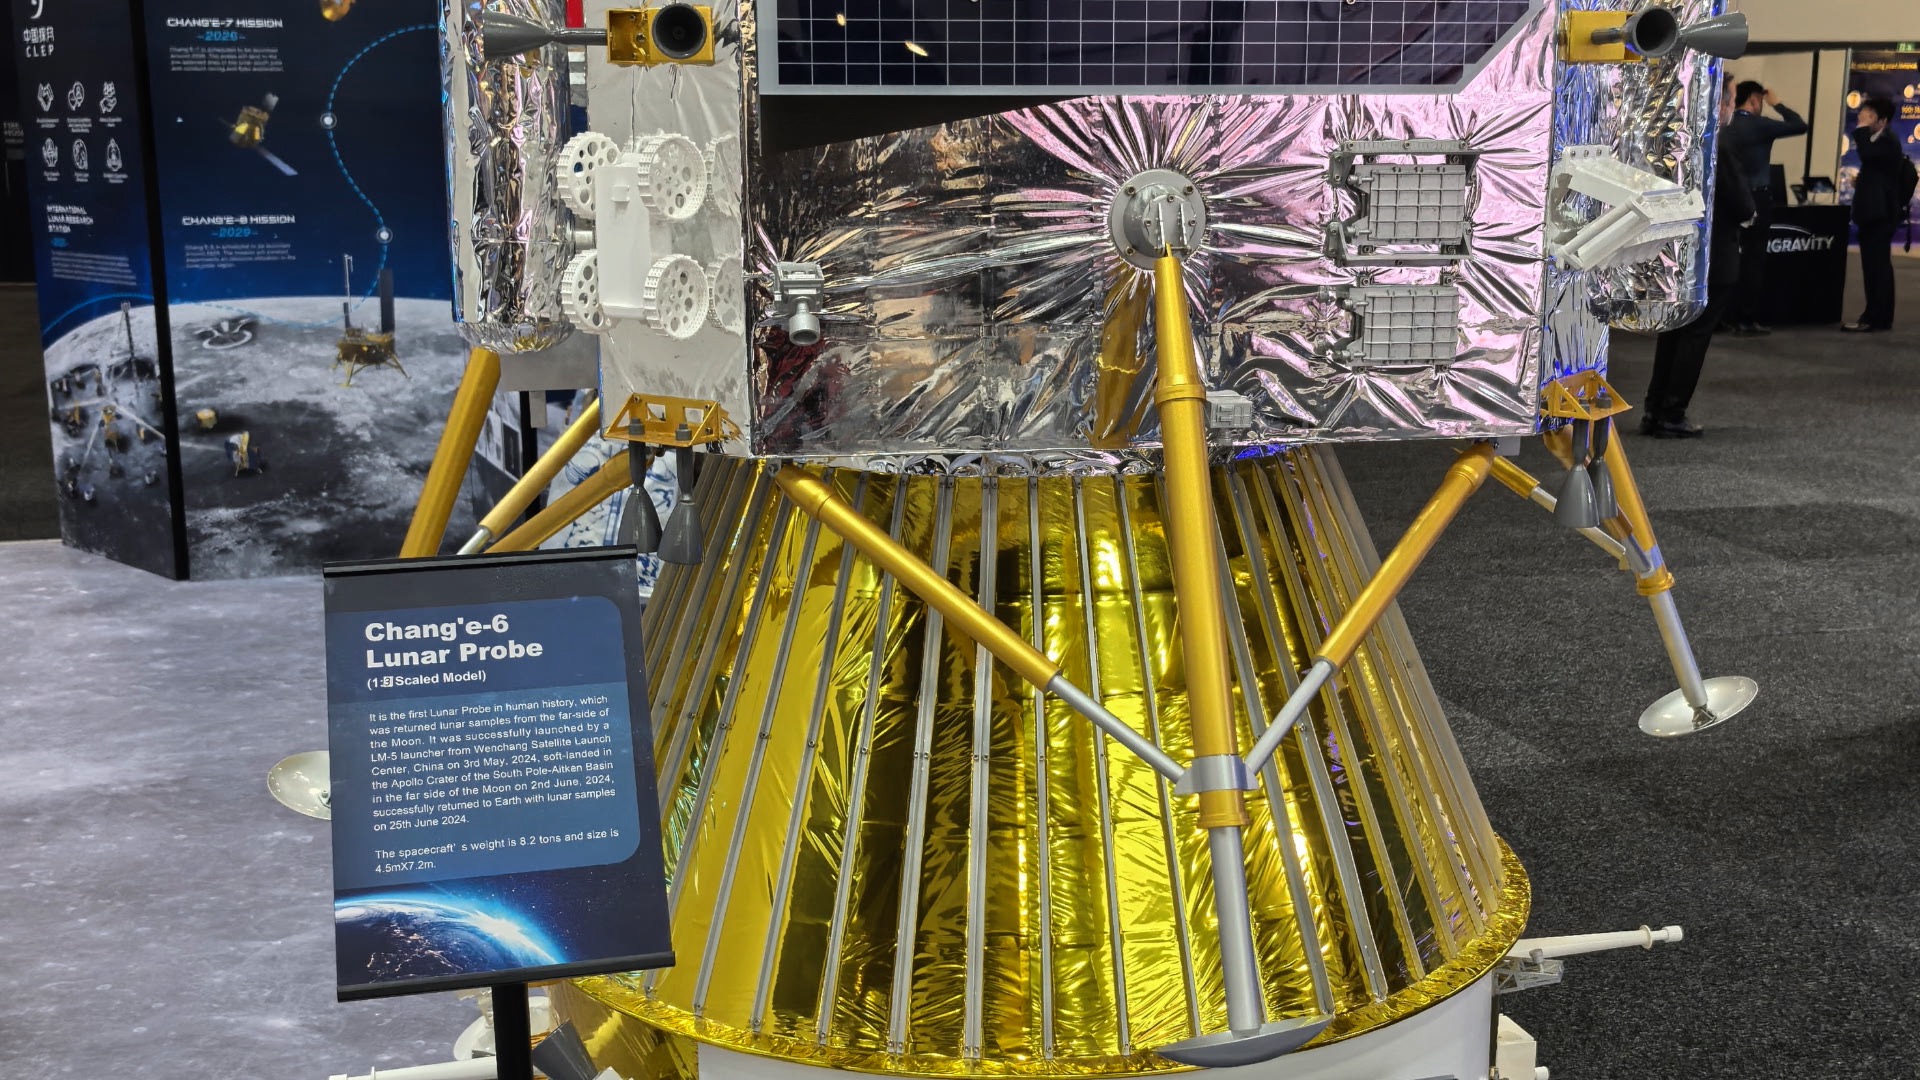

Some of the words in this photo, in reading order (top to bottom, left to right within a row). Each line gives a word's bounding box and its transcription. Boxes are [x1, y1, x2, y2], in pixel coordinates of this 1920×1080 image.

[166, 17, 234, 28] CHANG'E-7
[235, 18, 284, 28] MISSION
[26, 44, 54, 58] CLEP
[182, 216, 248, 226] CHANG'E-8
[249, 215, 296, 224] MISSION
[365, 613, 509, 642] Chang'e-6
[367, 649, 450, 668] Lunar
[460, 640, 543, 662] Probe
[395, 672, 440, 685] Scaled
[443, 670, 487, 683] Model)
[369, 713, 376, 722] It
[378, 712, 387, 721] is
[389, 711, 406, 721] the
[407, 709, 428, 719] first
[429, 708, 459, 717] Lunar
[461, 704, 491, 715] Probe
[493, 703, 503, 712] in
[505, 701, 539, 711] human
[541, 698, 577, 708] history,
[579, 695, 608, 705] which
[369, 726, 391, 735] was
[393, 721, 437, 733] returned
[439, 718, 466, 730] lunar
[468, 716, 511, 728] samples
[513, 714, 537, 724] from
[539, 712, 556, 722] the
[558, 709, 596, 720] far-side
[598, 707, 610, 717] of
[370, 740, 388, 748] the
[391, 737, 425, 747] Moon.
[428, 735, 436, 744] It
[439, 734, 462, 743] was
[464, 727, 532, 741] successfully
[534, 722, 584, 736] launched
[586, 722, 600, 733] by
[602, 722, 610, 730] a
[370, 751, 398, 763] LM-5
[400, 748, 446, 760] launcher
[447, 747, 471, 756] from
[473, 742, 528, 754] Wenchang
[530, 737, 572, 749] Satellite
[574, 733, 611, 746] Launch
[371, 765, 410, 776] Center,
[413, 762, 444, 773] China
[446, 761, 460, 770] on
[463, 758, 480, 769] 3rd
[482, 757, 509, 767] May,
[511, 753, 540, 764] 2024,
[543, 747, 600, 762] soft-landed
[602, 747, 612, 756] in
[371, 780, 388, 790] the
[390, 777, 424, 789] Apollo
[426, 775, 459, 785] Crater
[460, 772, 472, 782] of
[473, 771, 490, 781] the
[492, 768, 523, 779] South
[525, 763, 583, 777] Pole-Aitken
[585, 760, 614, 771] Basin
[372, 794, 382, 803] in
[385, 793, 403, 803] the
[405, 791, 421, 801] far
[423, 788, 446, 800] side
[448, 786, 460, 797] of
[461, 786, 479, 796] the
[482, 784, 511, 794] Moon
[514, 783, 528, 791] on
[530, 779, 551, 790] 2nd
[553, 778, 582, 788] June,
[585, 773, 614, 785] 2024,
[372, 803, 435, 817] successfully
[437, 799, 480, 812] returned
[482, 799, 492, 808] to
[494, 795, 522, 807] Earth
[523, 793, 545, 804] with
[547, 792, 572, 802] lunar
[574, 787, 616, 799] samples
[373, 823, 387, 832] on
[389, 819, 412, 830] 25th
[413, 818, 439, 828] June
[441, 814, 470, 825] 2024.
[374, 849, 396, 859] The
[469, 838, 505, 851] weight
[507, 837, 517, 847] is
[519, 835, 536, 846] 8.2
[538, 835, 562, 844] tons
[564, 831, 584, 842] and
[586, 829, 607, 840] size
[610, 827, 619, 837] is
[374, 860, 436, 873] 4.5mX7.2m.
